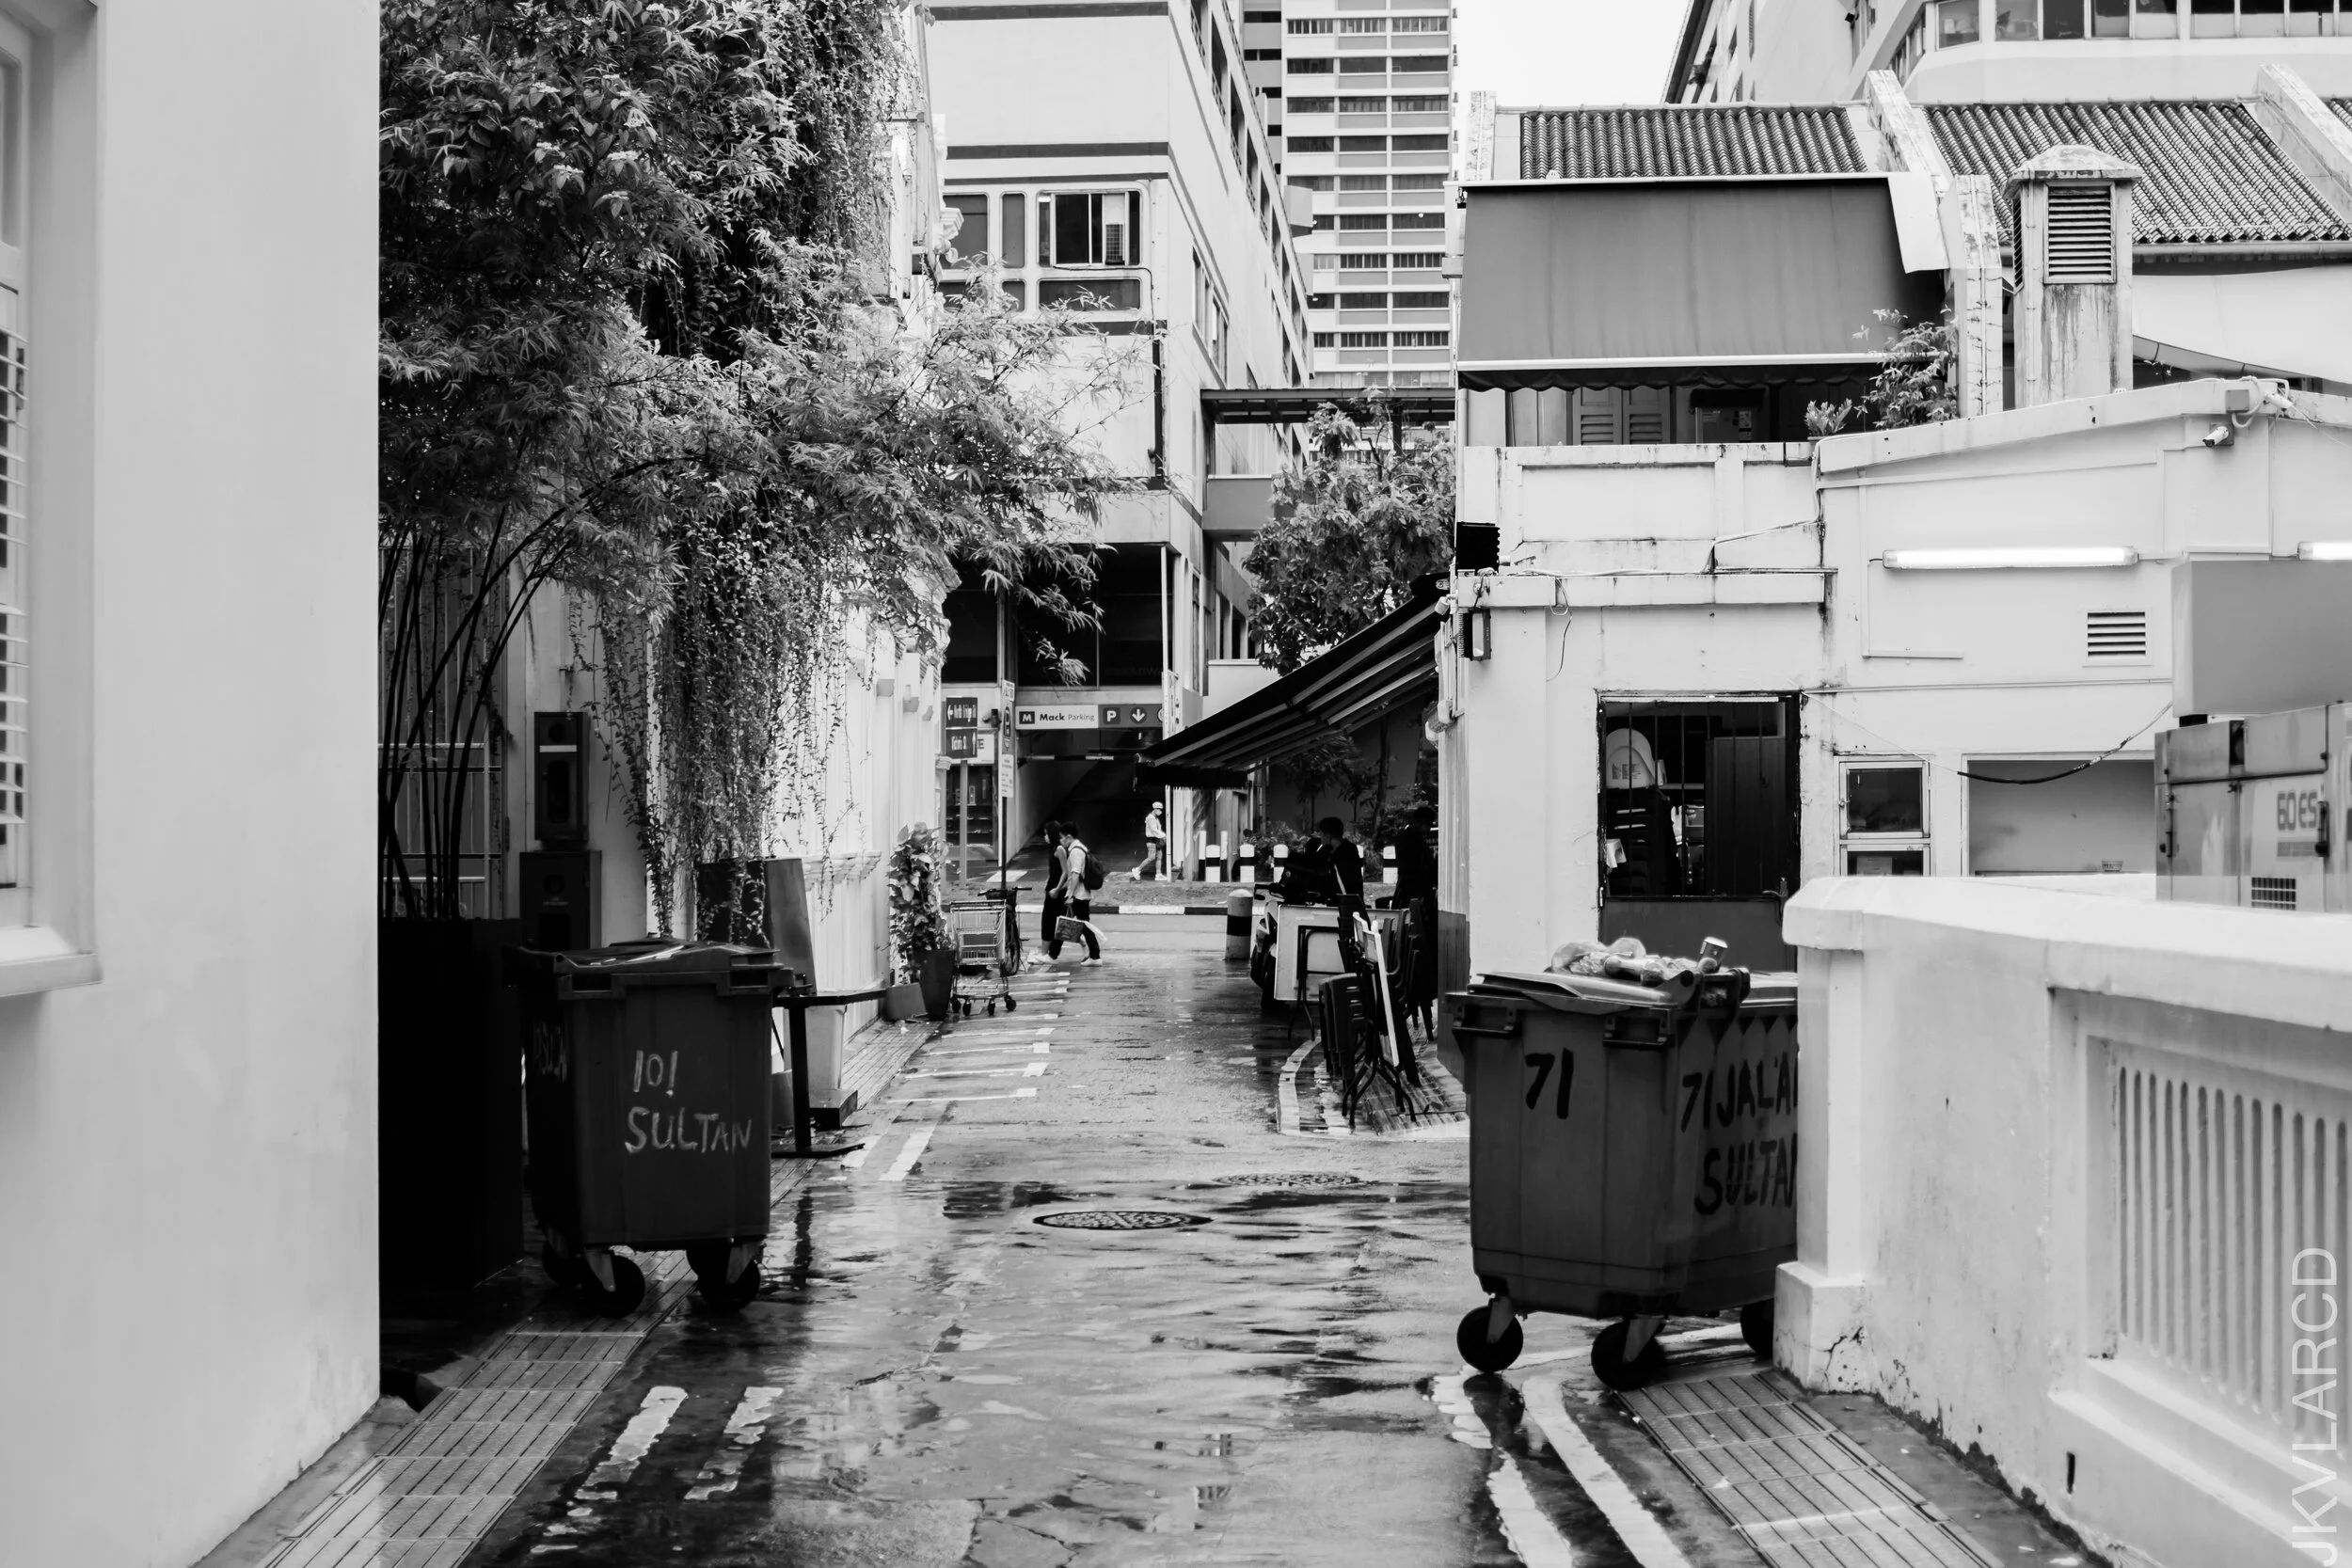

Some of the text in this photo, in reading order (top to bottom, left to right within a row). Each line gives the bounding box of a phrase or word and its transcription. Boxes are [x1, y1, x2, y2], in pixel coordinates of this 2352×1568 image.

[1040, 713, 1066, 721] Mack
[1068, 713, 1095, 722] Parking
[1106, 710, 1118, 722] P
[1525, 1048, 1573, 1119] 71
[1681, 1052, 1798, 1132] 71 JALA
[625, 1106, 752, 1153] SULTAN
